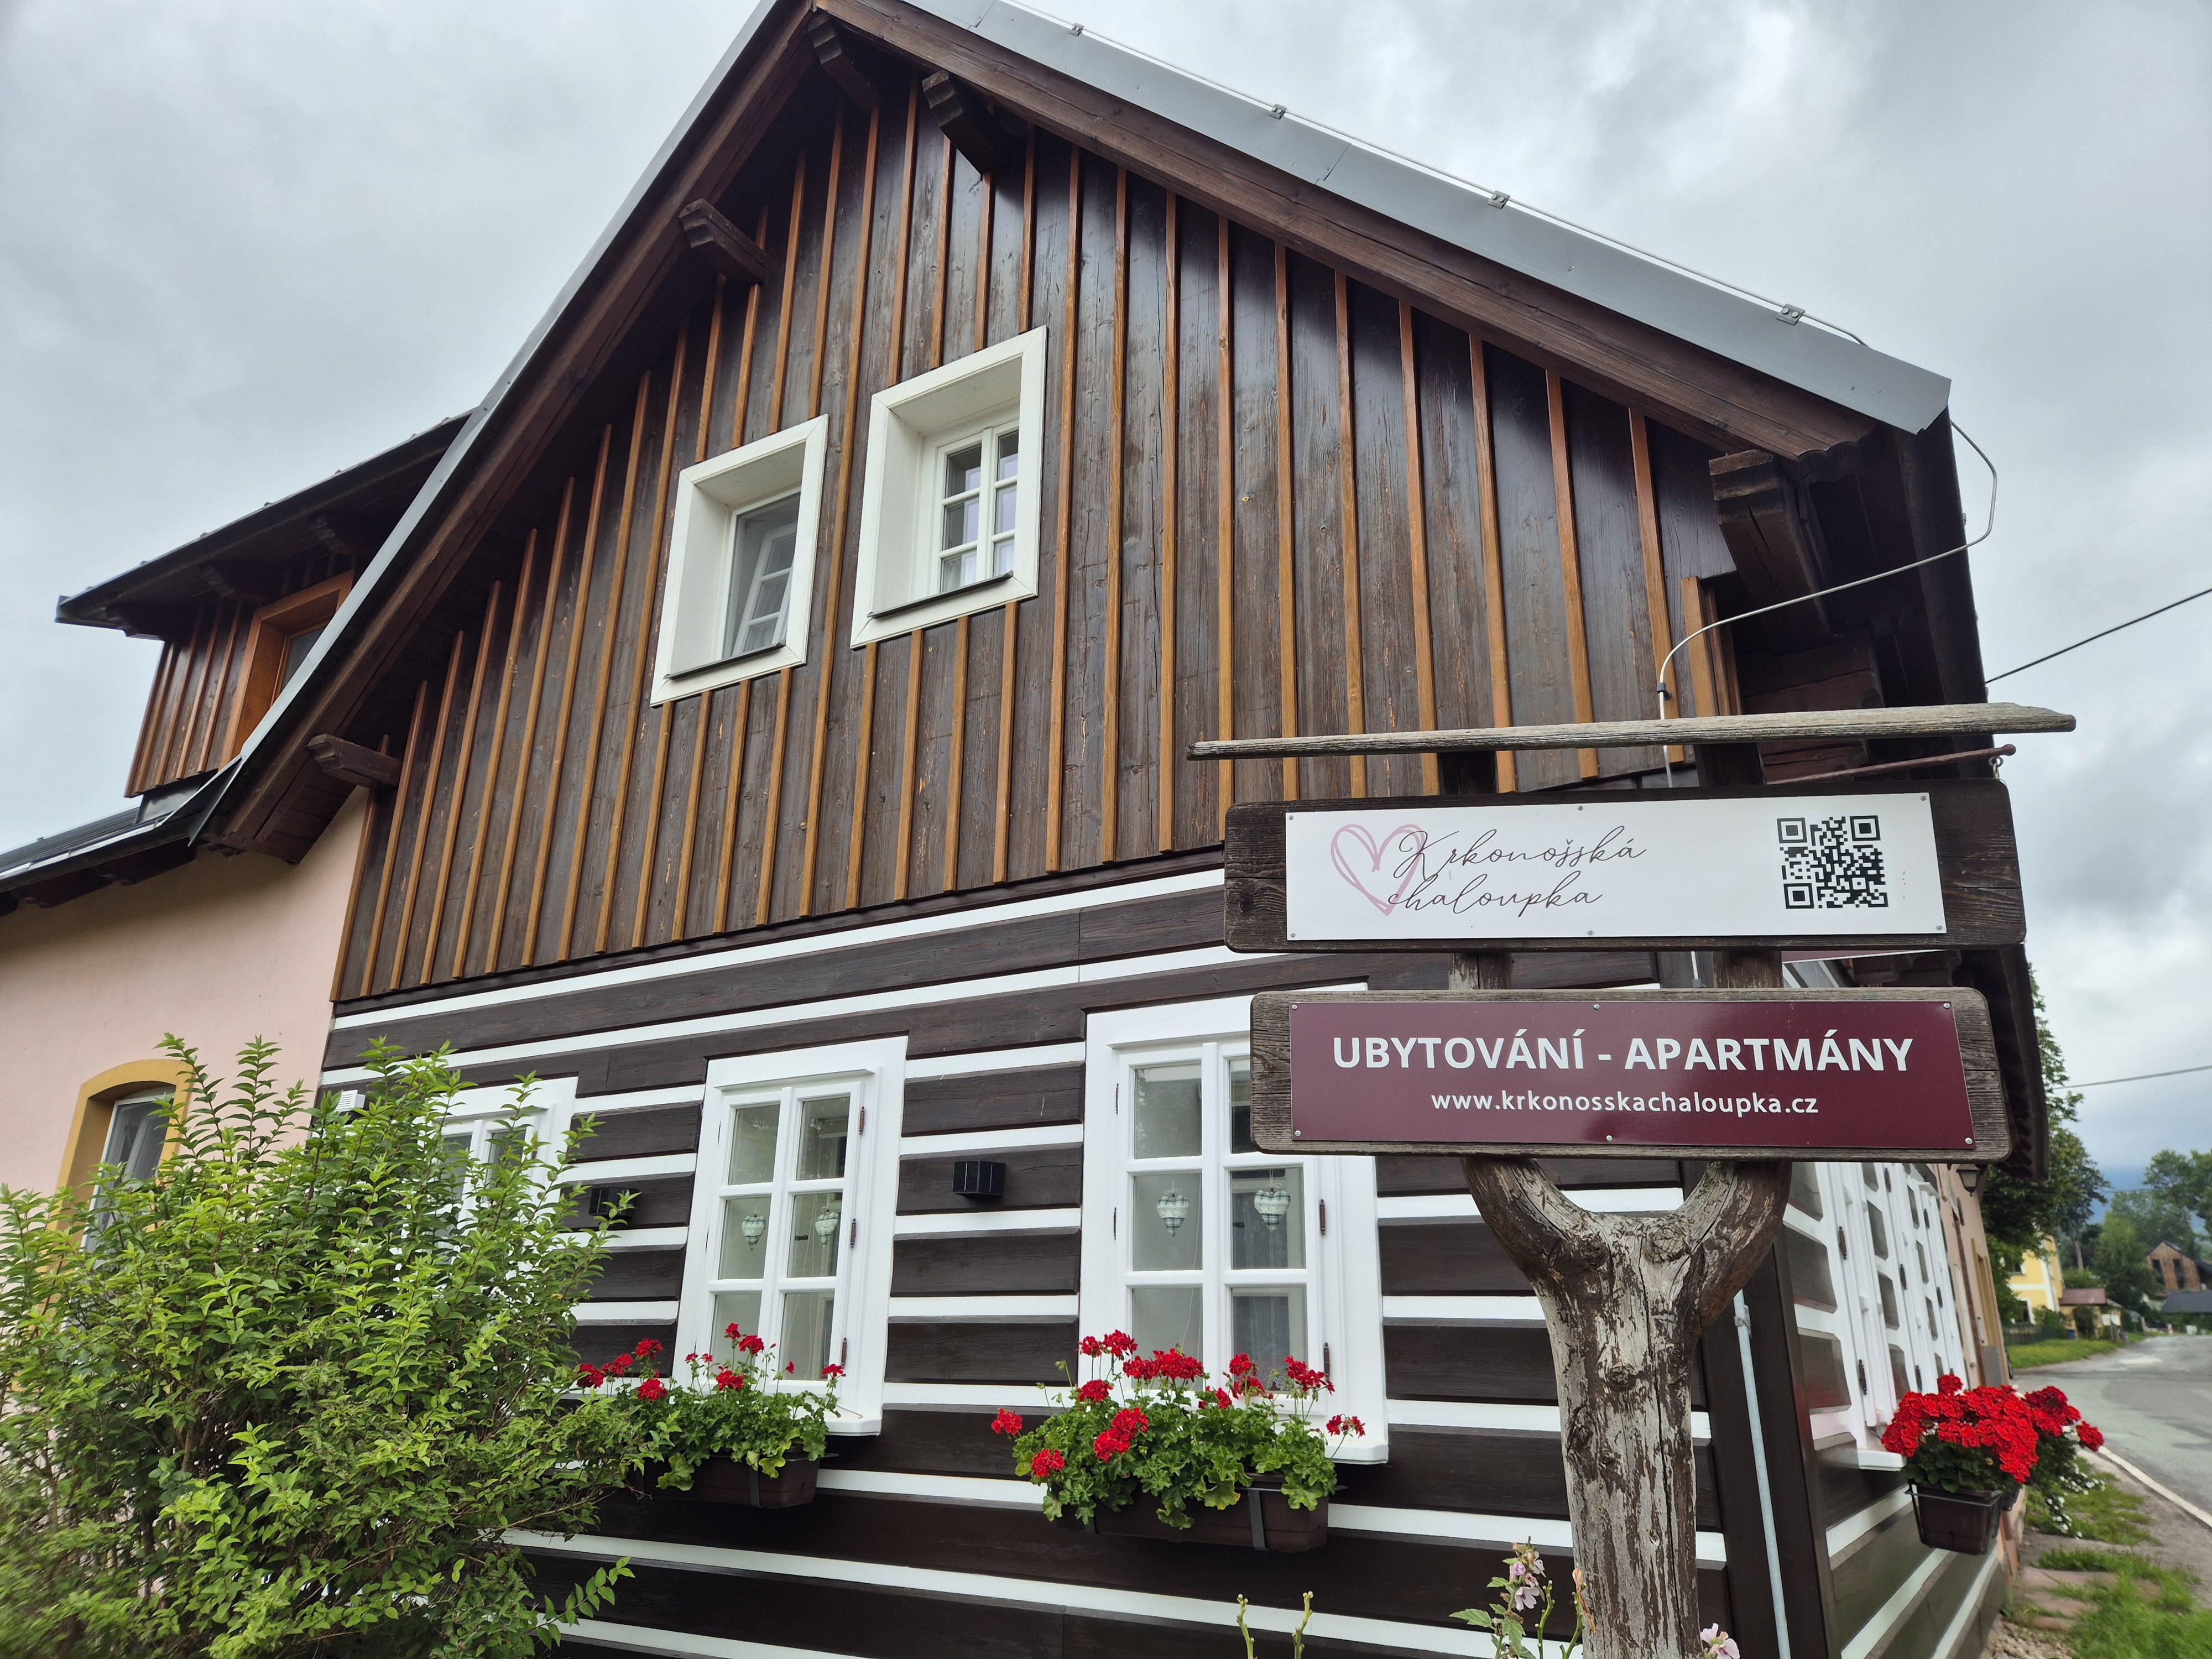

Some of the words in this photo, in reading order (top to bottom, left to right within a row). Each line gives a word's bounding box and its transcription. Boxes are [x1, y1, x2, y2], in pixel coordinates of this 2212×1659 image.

[1393, 825, 1647, 881] Krkonošská
[1387, 871, 1603, 917] chaloupka
[1333, 1029, 1585, 1070] UBYTOVÁNÍ
[1624, 1029, 1913, 1071] APARTMÁNY
[1431, 1089, 1819, 1118] www.krkonosskachaloupka.cz
